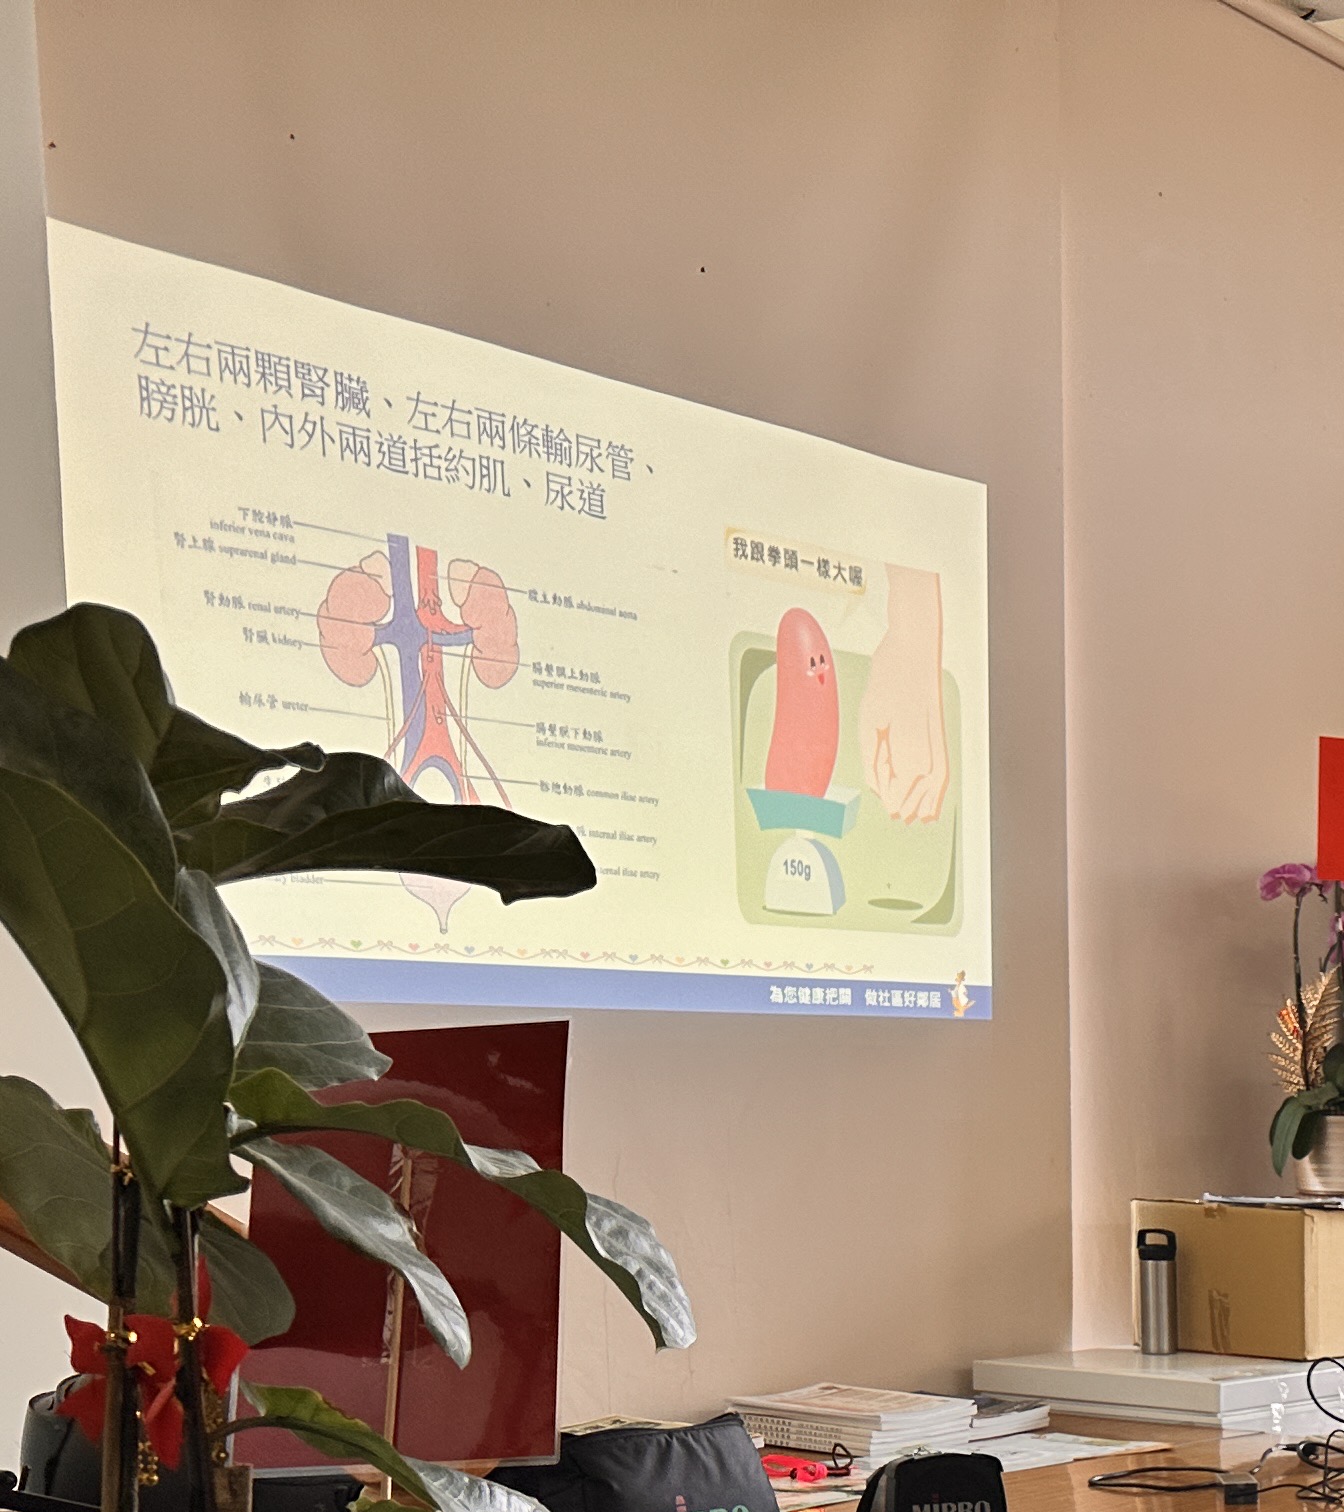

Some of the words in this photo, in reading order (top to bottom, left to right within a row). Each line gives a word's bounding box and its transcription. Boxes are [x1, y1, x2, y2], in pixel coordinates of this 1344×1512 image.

[137, 373, 607, 520] 膀胱、內外兩道括約肌、尿道
[783, 859, 811, 881] 150g
